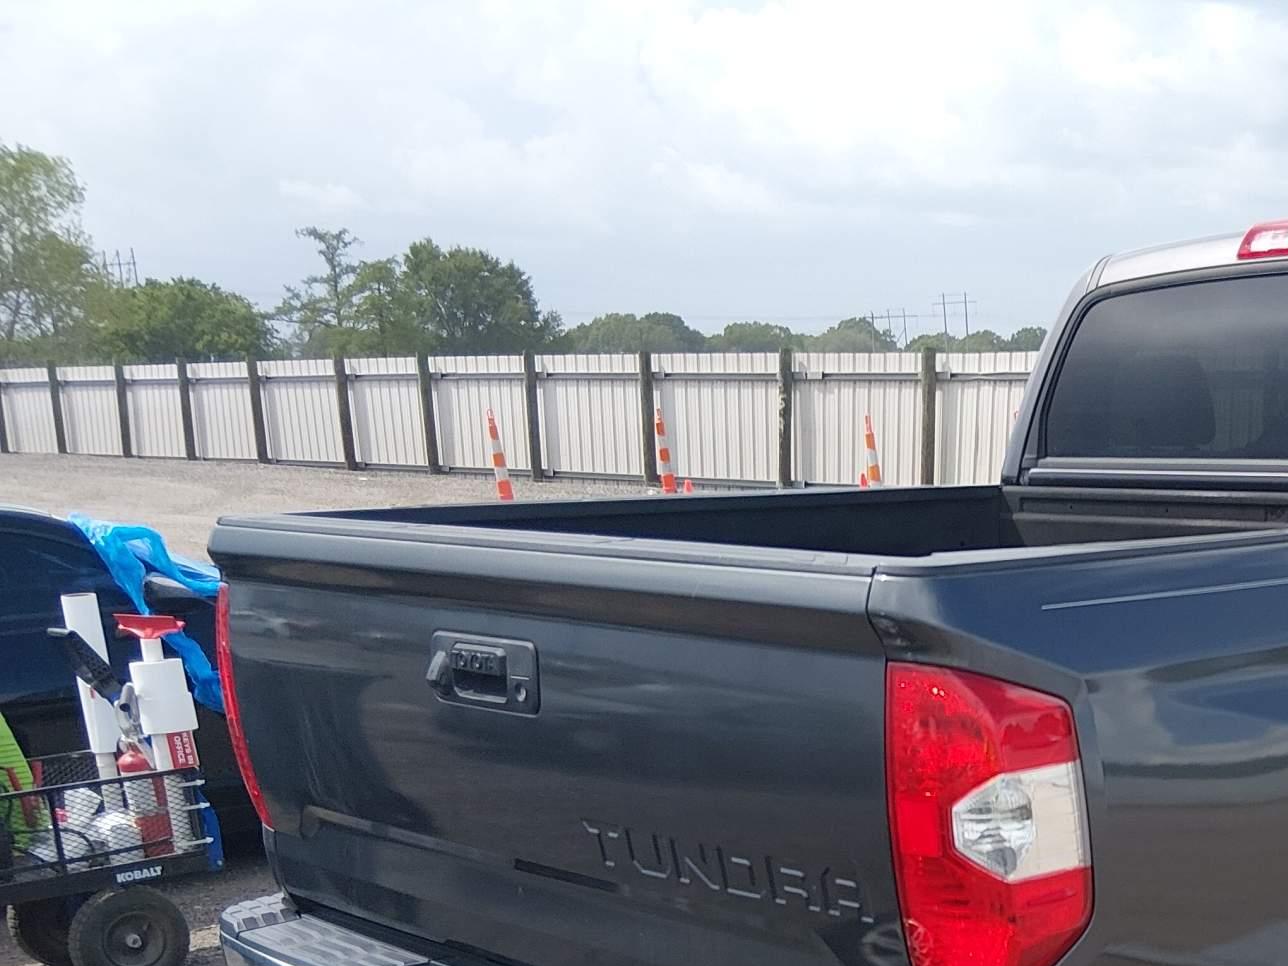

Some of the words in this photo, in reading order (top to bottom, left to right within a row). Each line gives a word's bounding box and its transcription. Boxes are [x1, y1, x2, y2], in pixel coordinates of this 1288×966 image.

[174, 735, 186, 764] OFFICE
[182, 732, 192, 754] KEYS
[116, 866, 162, 883] KOBALT
[581, 818, 874, 923] TUNDRA
